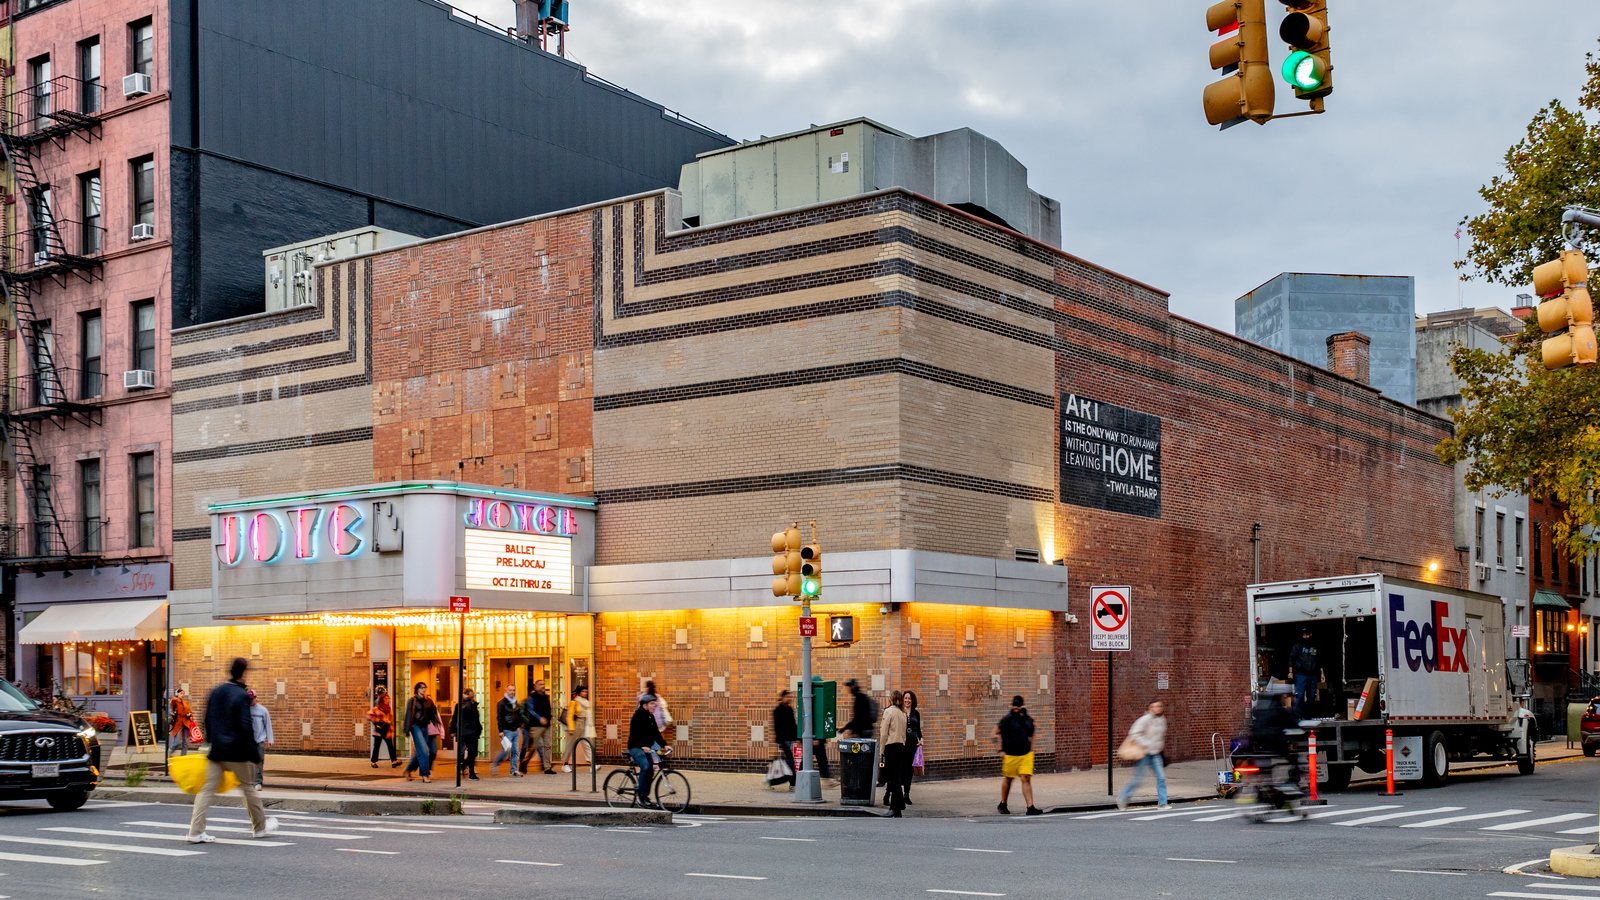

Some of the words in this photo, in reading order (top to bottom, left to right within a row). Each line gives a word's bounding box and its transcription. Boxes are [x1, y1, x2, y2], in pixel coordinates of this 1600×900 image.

[1065, 419, 1071, 431] IS
[1072, 422, 1085, 435] THE
[1086, 425, 1105, 440] ONLY
[1105, 430, 1119, 442] WAY
[1120, 433, 1128, 445] TO
[1129, 435, 1141, 448] RUN
[1141, 439, 1159, 451] AWAY
[1065, 436, 1100, 455] WITHOUT
[1065, 451, 1100, 471] LEAVING
[1102, 444, 1158, 483] HOME.
[1135, 485, 1158, 500] THARP
[463, 499, 578, 536] JOYCE
[214, 502, 404, 566] JOYCE
[505, 544, 536, 555] BALLET
[496, 557, 546, 569] PRELJOCAJ
[492, 577, 508, 587] OCT
[510, 578, 518, 588] 21
[519, 578, 540, 589] THRU
[541, 580, 552, 590] 26
[1388, 593, 1470, 674] FedEx
